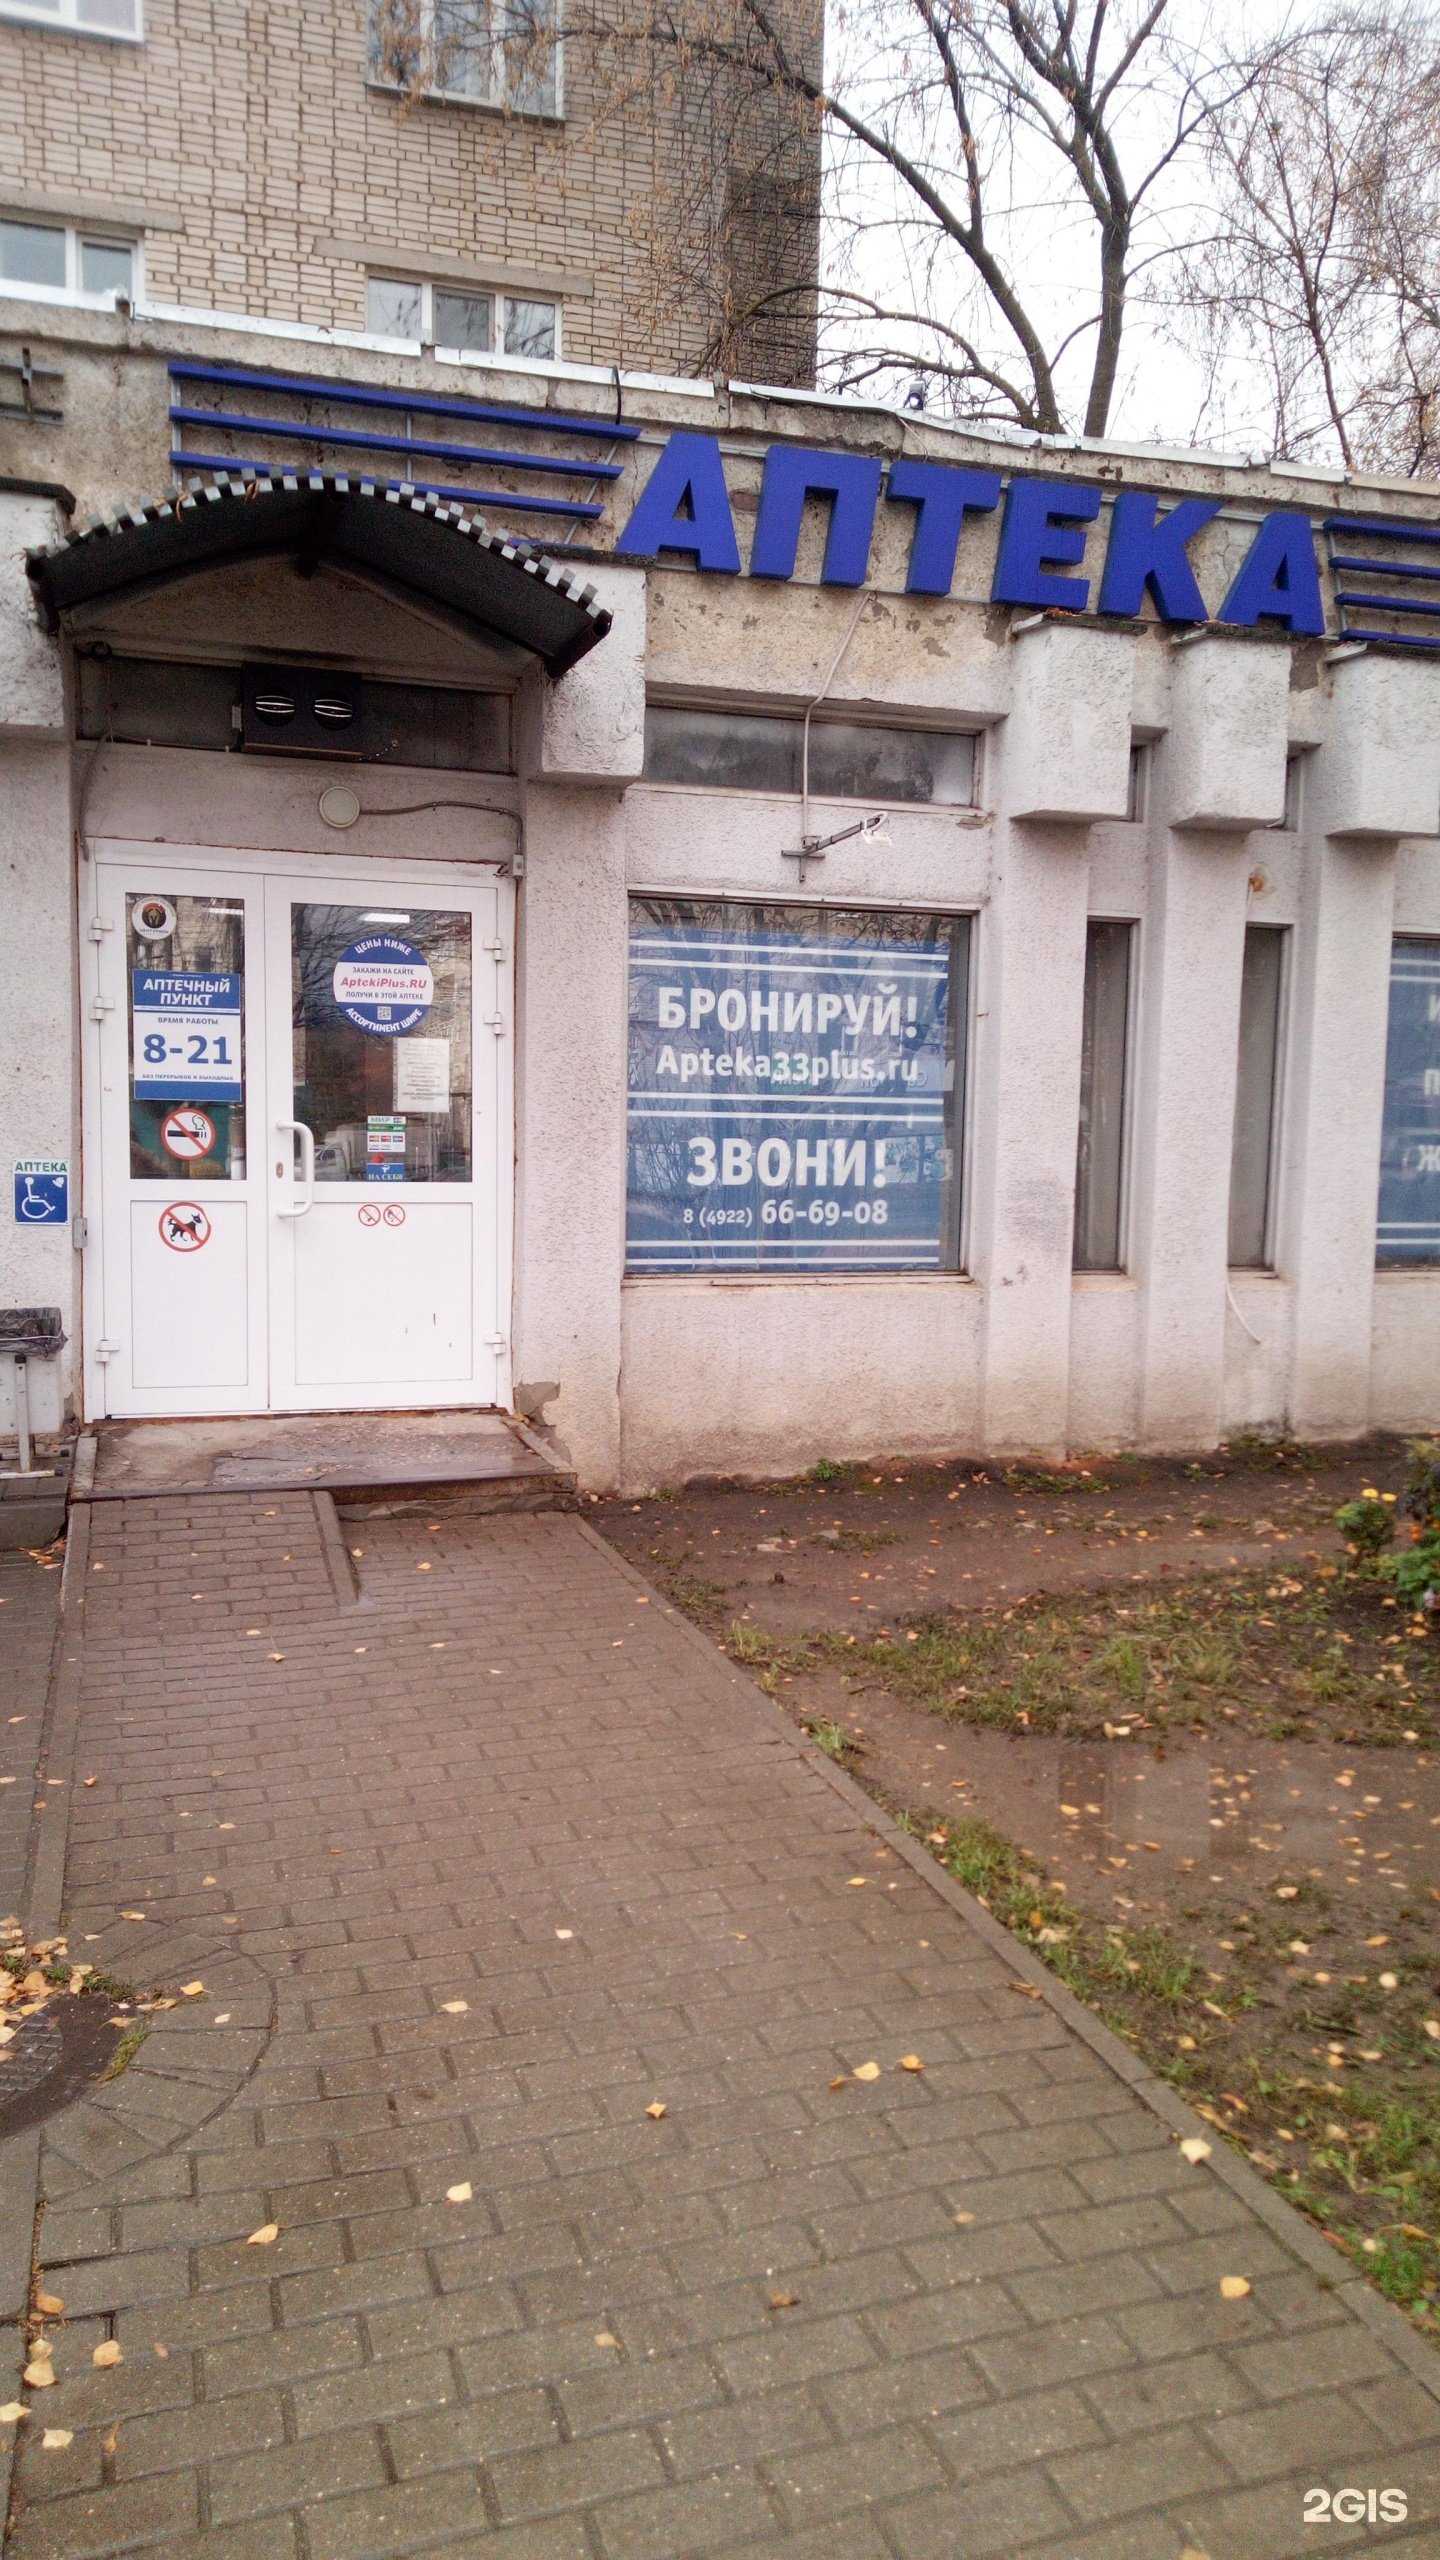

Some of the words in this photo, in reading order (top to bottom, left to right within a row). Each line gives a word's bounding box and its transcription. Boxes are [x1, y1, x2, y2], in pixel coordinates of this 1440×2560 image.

[615, 431, 1326, 637] АПТЕКА
[354, 938, 381, 954] ЦЕНЫ
[384, 938, 412, 956] НИЖЕ
[353, 966, 380, 974] ЗАКАЖИ
[382, 967, 392, 975] НА
[393, 967, 415, 976] САЙТЕ
[143, 978, 230, 993] АПТЕЧНЫЙ
[340, 976, 427, 989] AptekiPlus.RU
[160, 993, 213, 1006] ПУНКТ
[345, 991, 373, 999] ПОЛУЧИ
[345, 1007, 400, 1033] АССОРТИМЕНТ
[400, 1007, 423, 1029] ШИРЕ
[657, 983, 918, 1039] БРОНИРУЙ!
[157, 1016, 184, 1025] ВРЕМЯ
[186, 1017, 219, 1026] РАБОТЫ
[143, 1033, 233, 1065] 8-21
[656, 1045, 918, 1086] Apteka33plus.ru
[15, 1161, 68, 1172] АПТЕКА
[687, 1136, 888, 1189] ЗВОНИ!
[683, 1208, 695, 1224] 8
[699, 1206, 753, 1229] (4922)
[761, 1199, 889, 1227] 66-69-08
